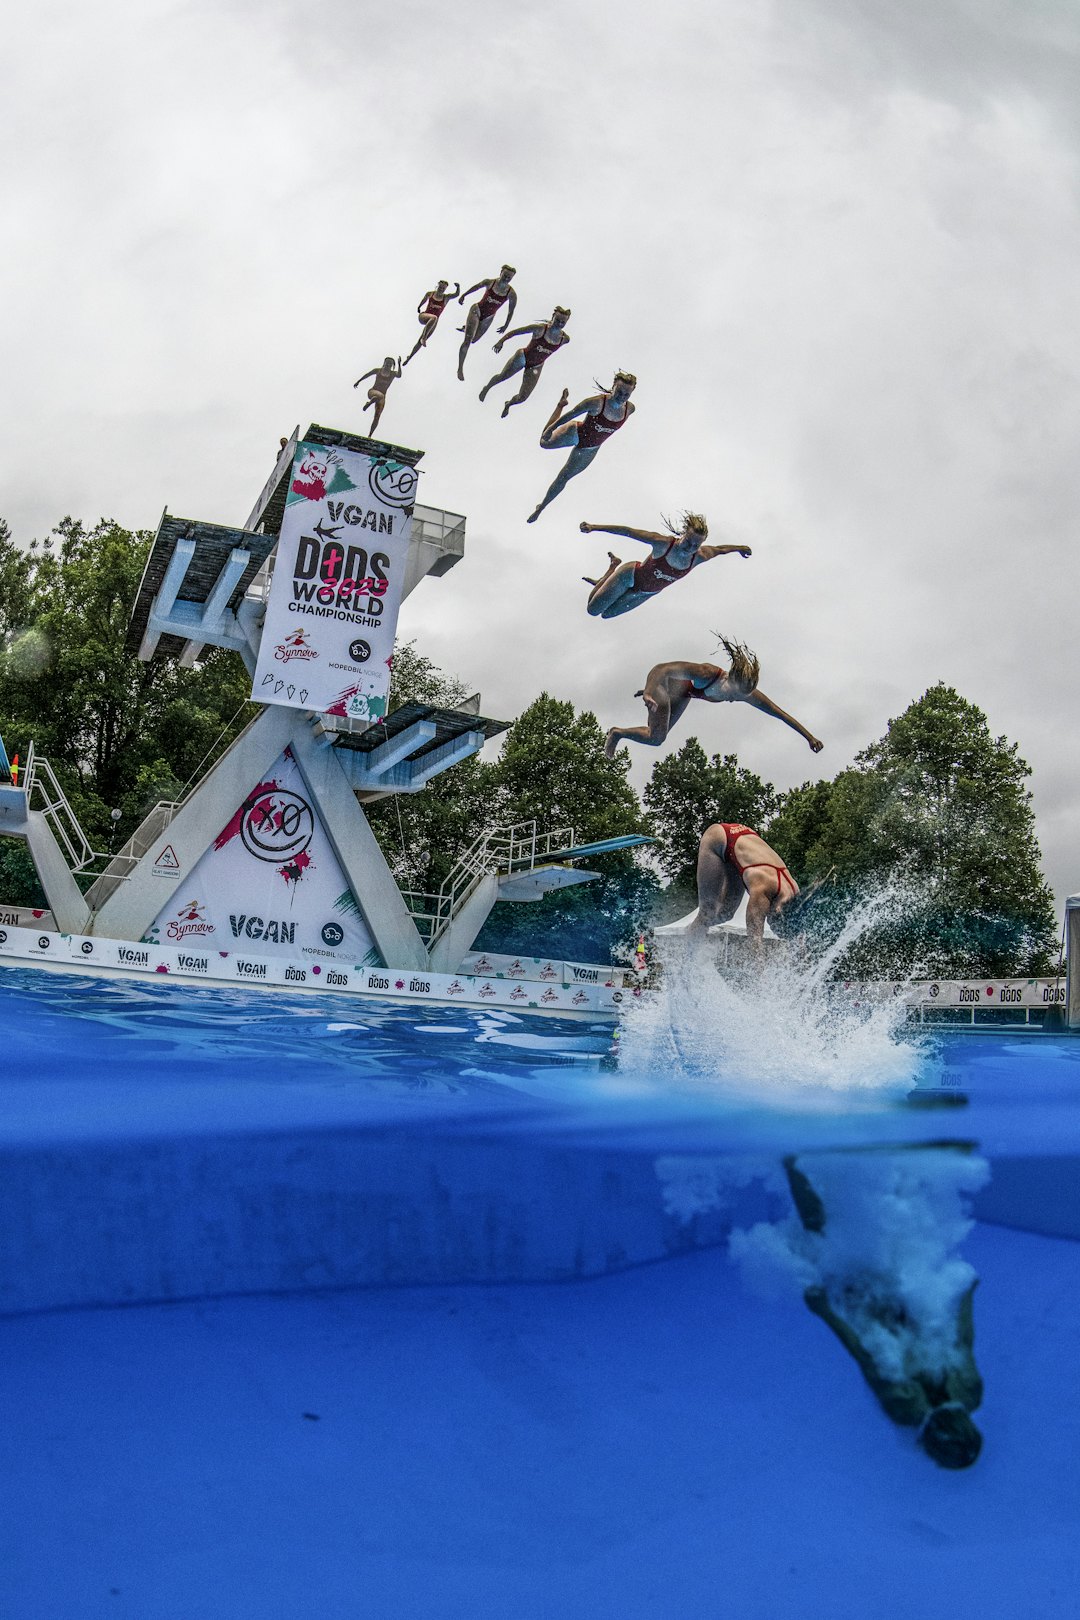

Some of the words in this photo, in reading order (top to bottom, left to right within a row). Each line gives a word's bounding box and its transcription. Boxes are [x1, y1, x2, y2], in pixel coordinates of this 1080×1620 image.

[327, 500, 394, 535] VGAN
[320, 577, 389, 597] 2023
[293, 580, 384, 616] WORLD
[288, 602, 382, 628] CHAMPIONSHIP
[328, 662, 363, 674] MOPEDBIL
[229, 914, 296, 944] VGAN
[118, 949, 148, 962] VGAN
[301, 947, 336, 959] MOPEDBIL
[178, 956, 208, 969] VGAN
[237, 962, 266, 974] VGAN
[573, 968, 598, 980] VGAN
